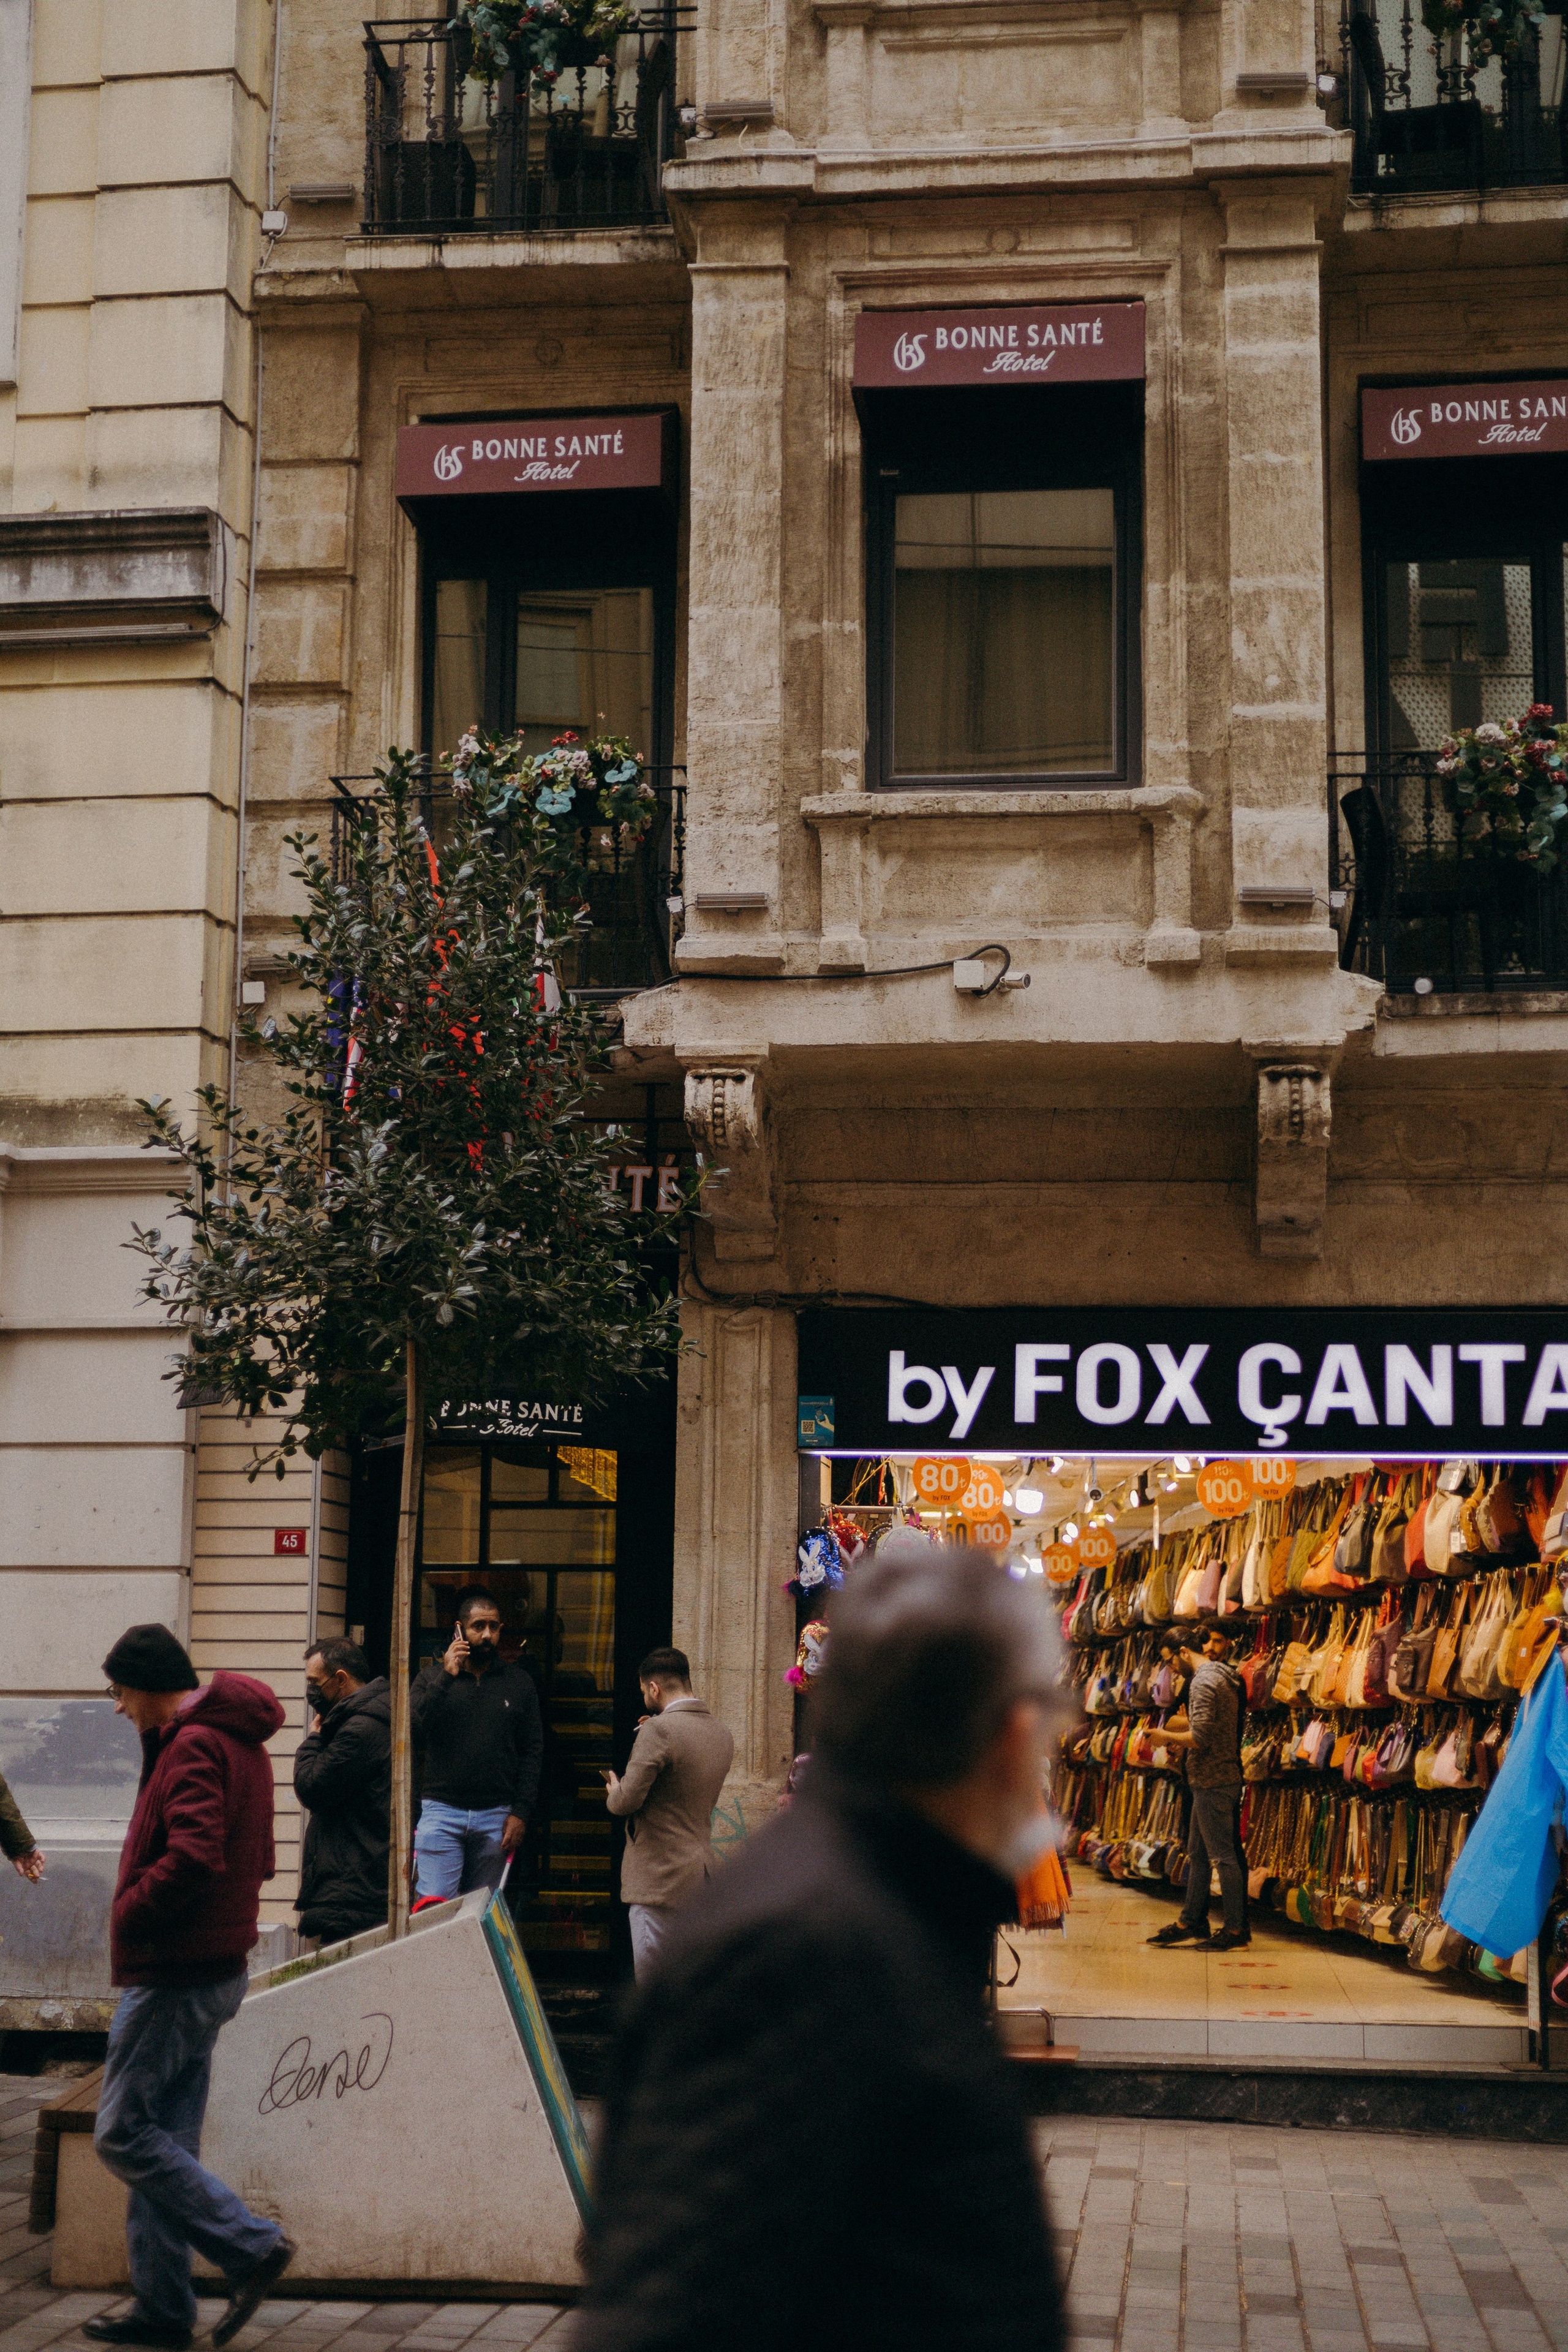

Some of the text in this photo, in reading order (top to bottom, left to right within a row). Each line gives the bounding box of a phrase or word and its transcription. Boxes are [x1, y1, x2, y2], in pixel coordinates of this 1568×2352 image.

[935, 317, 1104, 350] BONNE SANTÉ
[983, 350, 1056, 372] Hotel
[1431, 399, 1512, 423] BONNE
[1478, 422, 1548, 444] Hotel
[472, 429, 624, 460] BONNE SANTÉ
[514, 460, 580, 481] Hotel
[888, 1342, 1568, 1448] by FOX ÇANTA
[518, 1401, 583, 1423] SANTÉ
[282, 1535, 298, 1548] 45
